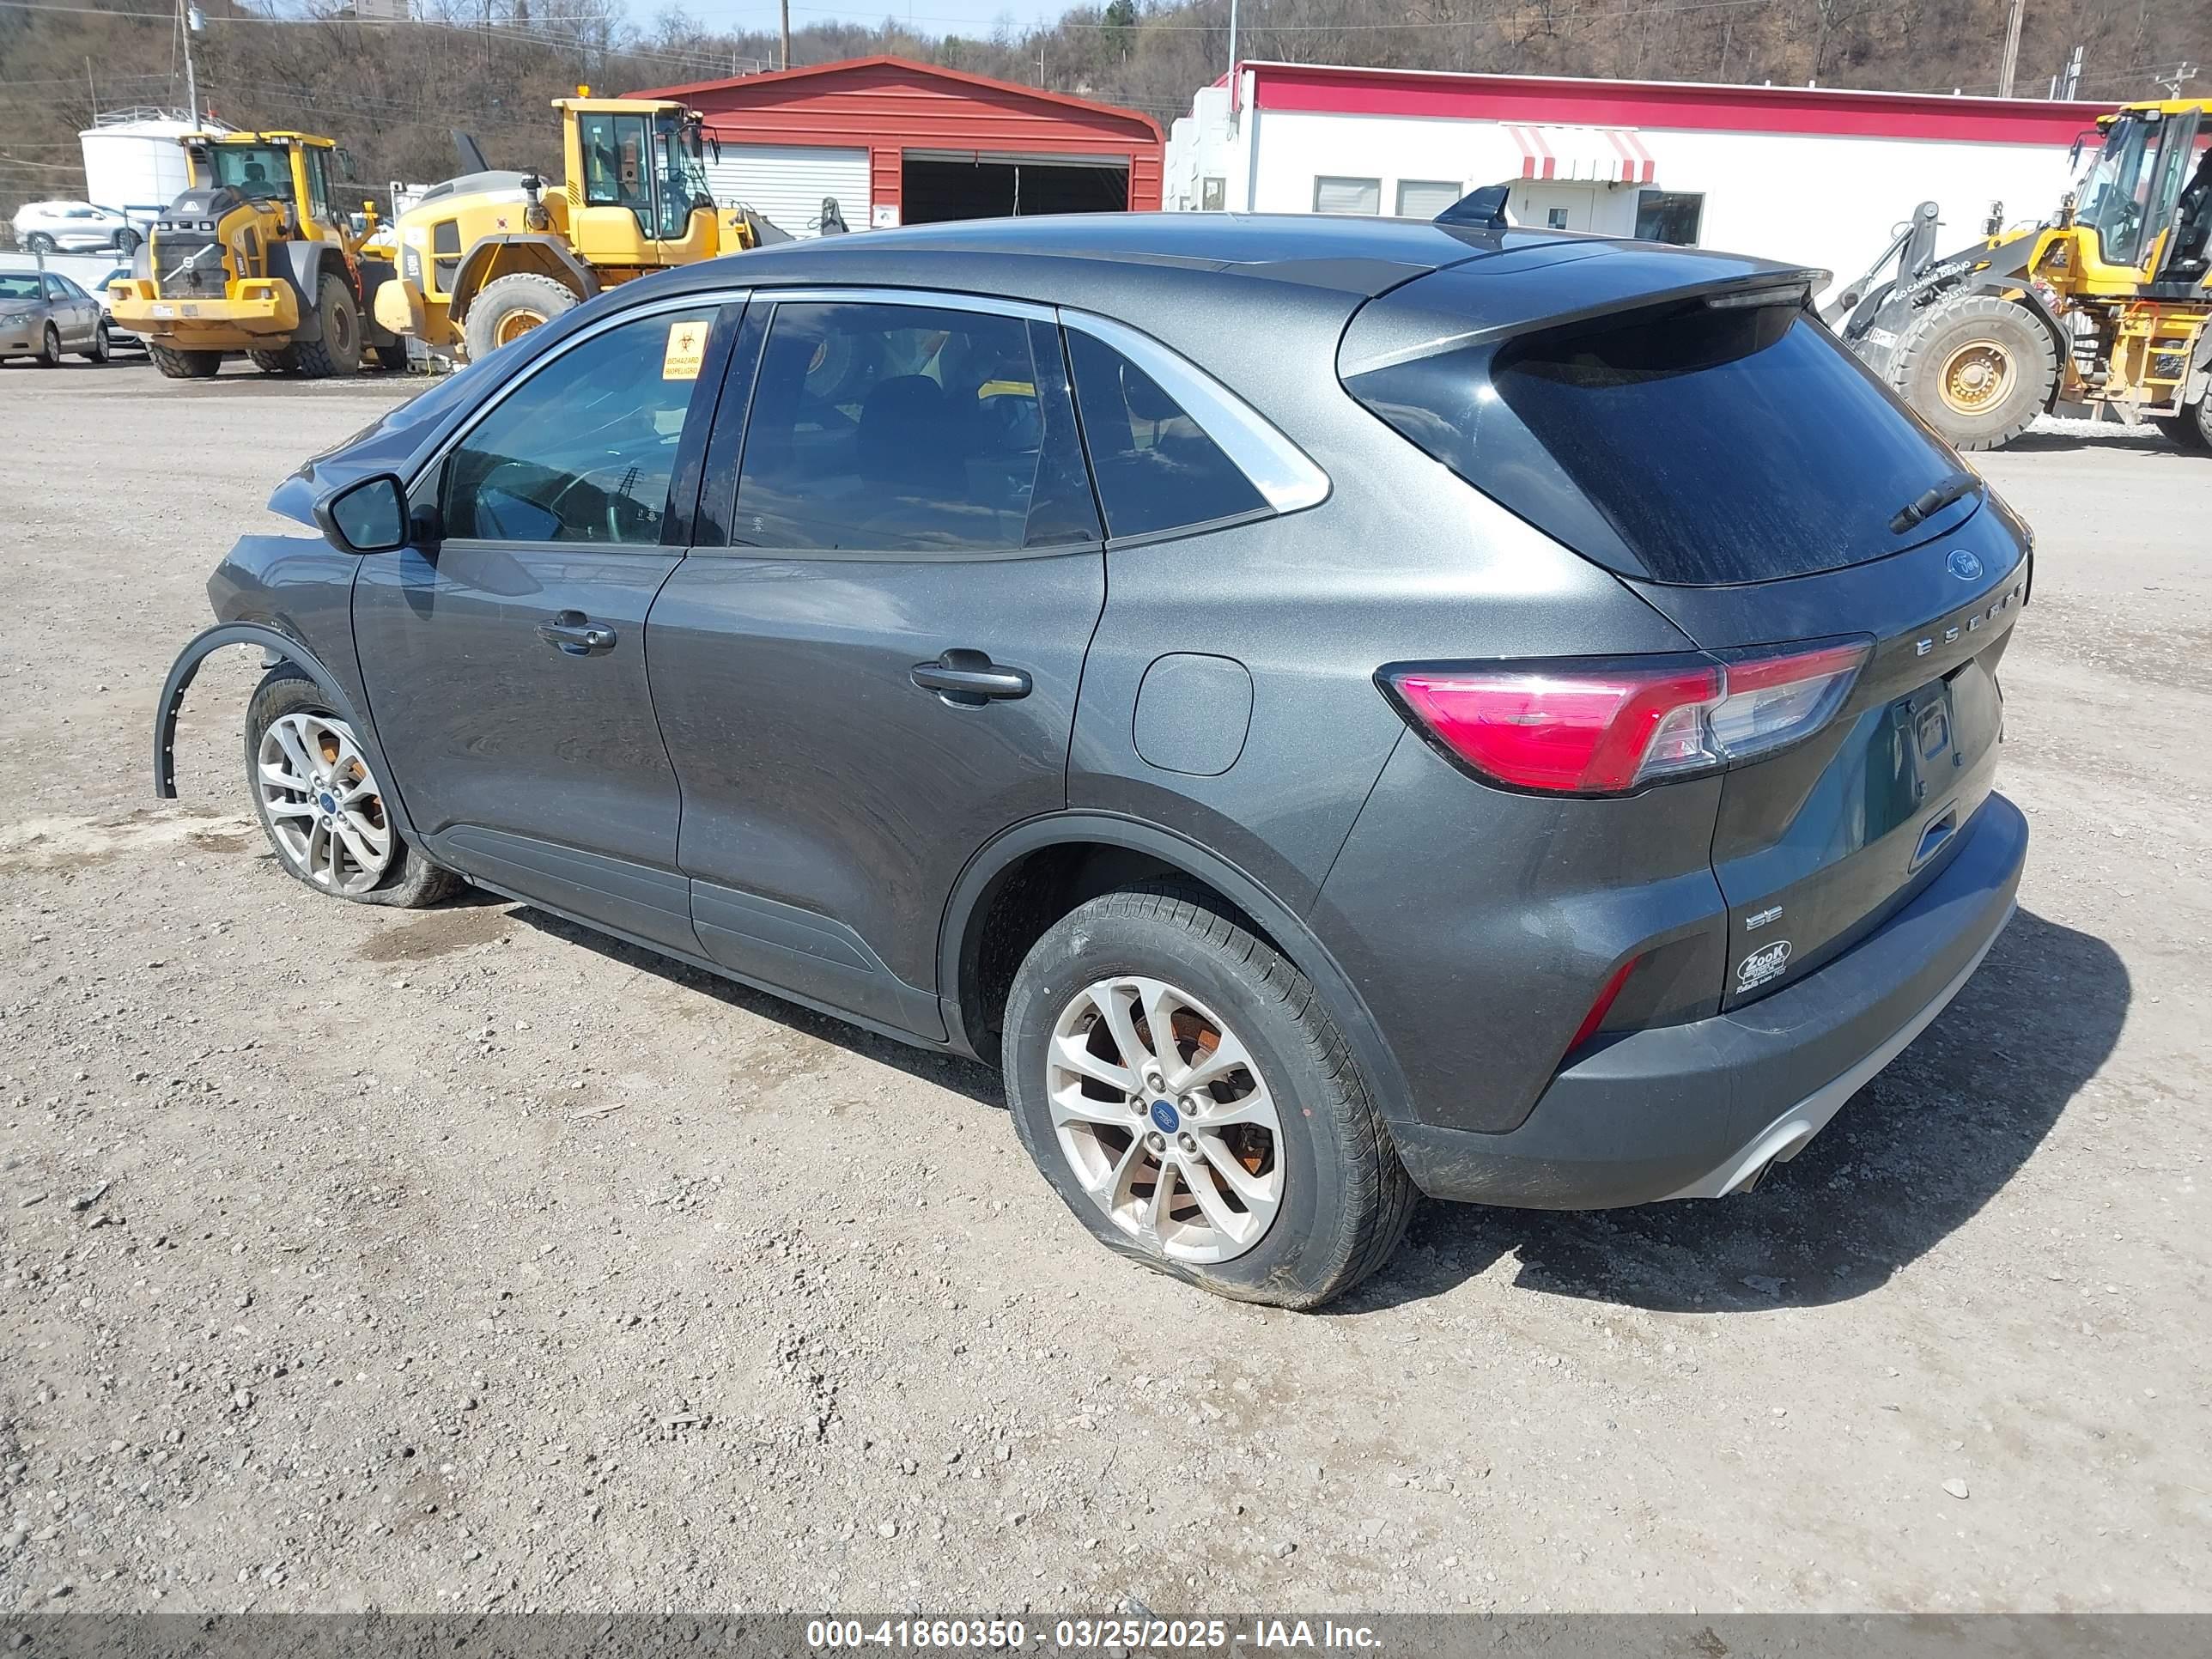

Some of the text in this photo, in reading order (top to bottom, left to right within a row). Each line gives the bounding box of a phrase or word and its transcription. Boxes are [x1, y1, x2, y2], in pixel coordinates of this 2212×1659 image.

[1894, 261, 1971, 302] NO CAMINE DEBAJO
[1746, 906, 1784, 931] SE
